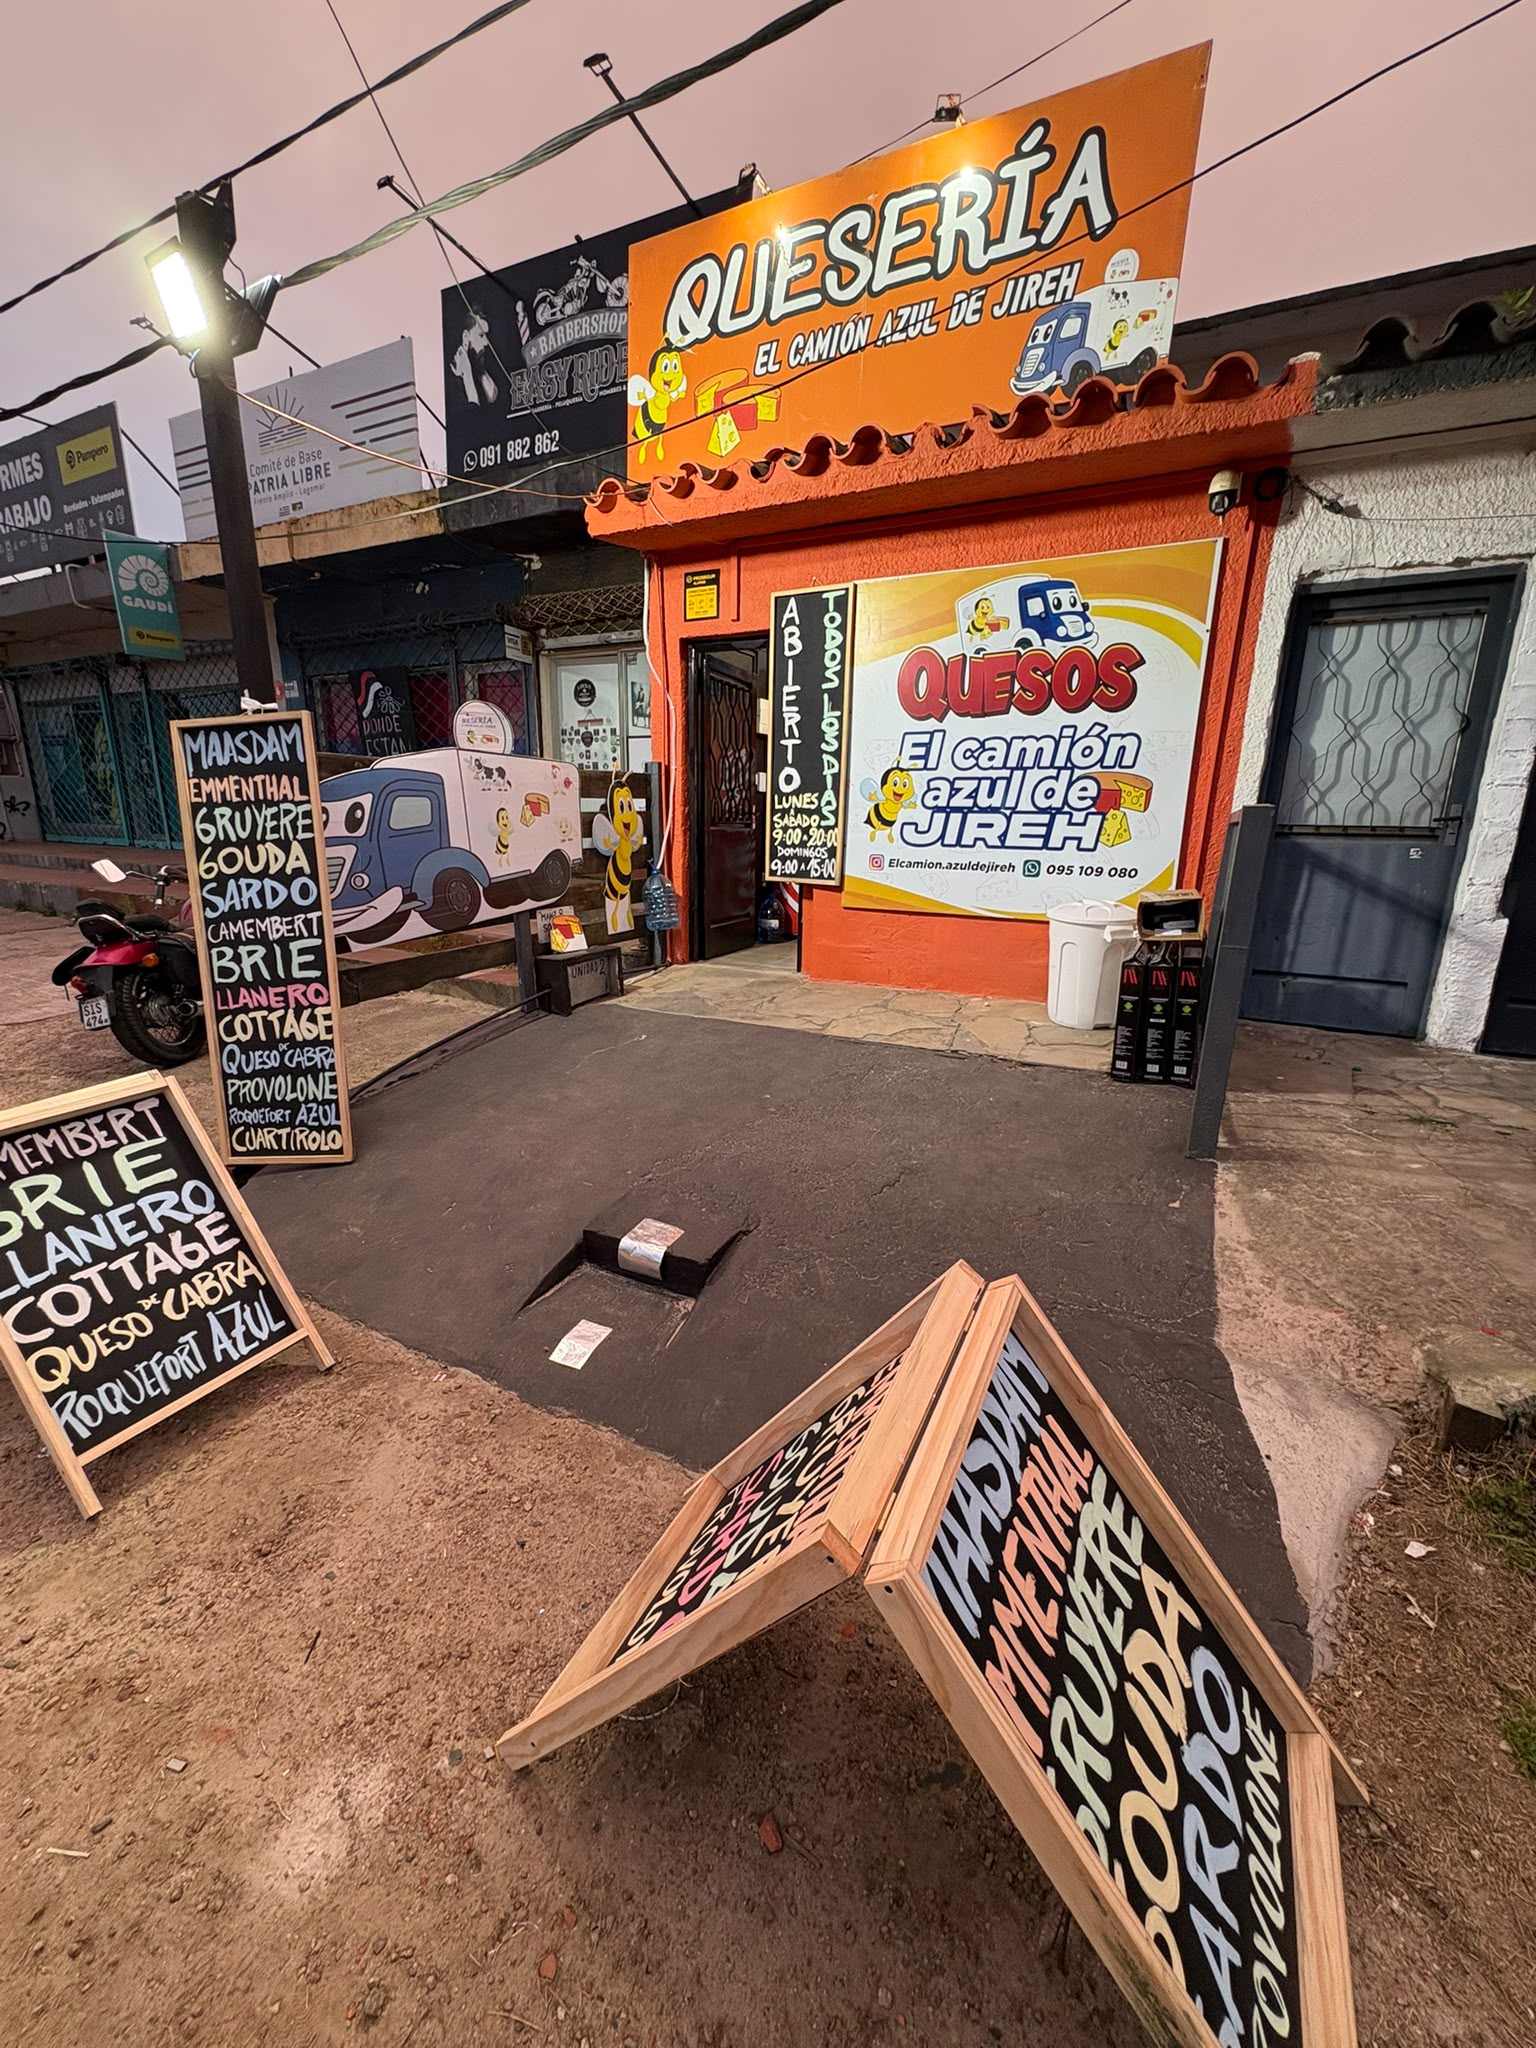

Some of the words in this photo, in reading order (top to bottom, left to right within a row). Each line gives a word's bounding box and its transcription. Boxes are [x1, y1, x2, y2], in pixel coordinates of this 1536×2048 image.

[665, 117, 1117, 347] QUESERÍA
[538, 312, 628, 358] BARBERSHOP
[754, 339, 780, 376] EL
[788, 313, 871, 368] CAMIÓN
[875, 298, 941, 348] AZUL
[946, 286, 988, 331] DE
[991, 260, 1083, 318] JIREH
[76, 444, 108, 463] Pampero
[249, 457, 282, 478] Comité
[284, 455, 297, 468] de
[298, 448, 323, 465] Base
[479, 443, 501, 468] 091
[507, 436, 531, 463] 882
[534, 430, 560, 456] 862
[292, 461, 332, 486] LIBRE
[821, 590, 847, 690] TODOS
[778, 597, 803, 793] ABIERTO
[897, 643, 1146, 723] QUESOS
[820, 692, 841, 752] LOS
[183, 723, 305, 777] MAASDAM
[897, 730, 946, 772] El
[951, 723, 1143, 772] camión
[187, 775, 310, 803] EMMENTHAL
[774, 792, 819, 810] LUNES
[921, 769, 1024, 811] azul
[1028, 769, 1101, 812] de
[772, 828, 802, 846] 9:00
[807, 827, 838, 848] 20:00
[899, 810, 1107, 852] JIREH
[771, 858, 798, 876] 9:00
[806, 857, 836, 878] 15:00
[888, 857, 1016, 874] Elcamion.azuldejireh
[1046, 864, 1074, 877] 095
[1078, 864, 1102, 878] 109
[1107, 866, 1139, 879] 080
[202, 876, 318, 919] SARDO
[207, 911, 323, 944] CAMEMBERT
[210, 938, 322, 984] BRIE
[571, 961, 599, 979] UNIDAD
[599, 958, 606, 976] 2
[83, 1002, 102, 1017] SIS
[216, 982, 329, 1011] LLANERO
[222, 1043, 280, 1075] QUESO
[284, 1046, 336, 1070] CABRA
[226, 1071, 338, 1105] PROVOLONE
[229, 1106, 291, 1126] ROQUEFORT
[295, 1103, 341, 1127] AZUL
[231, 1126, 343, 1153] CUARTIROLO
[26, 1311, 154, 1393] QUESO
[137, 1292, 161, 1311] DE
[162, 1250, 267, 1321] CABRA
[50, 1330, 208, 1448] ROQUEFORT
[205, 1289, 287, 1363] AZUL
